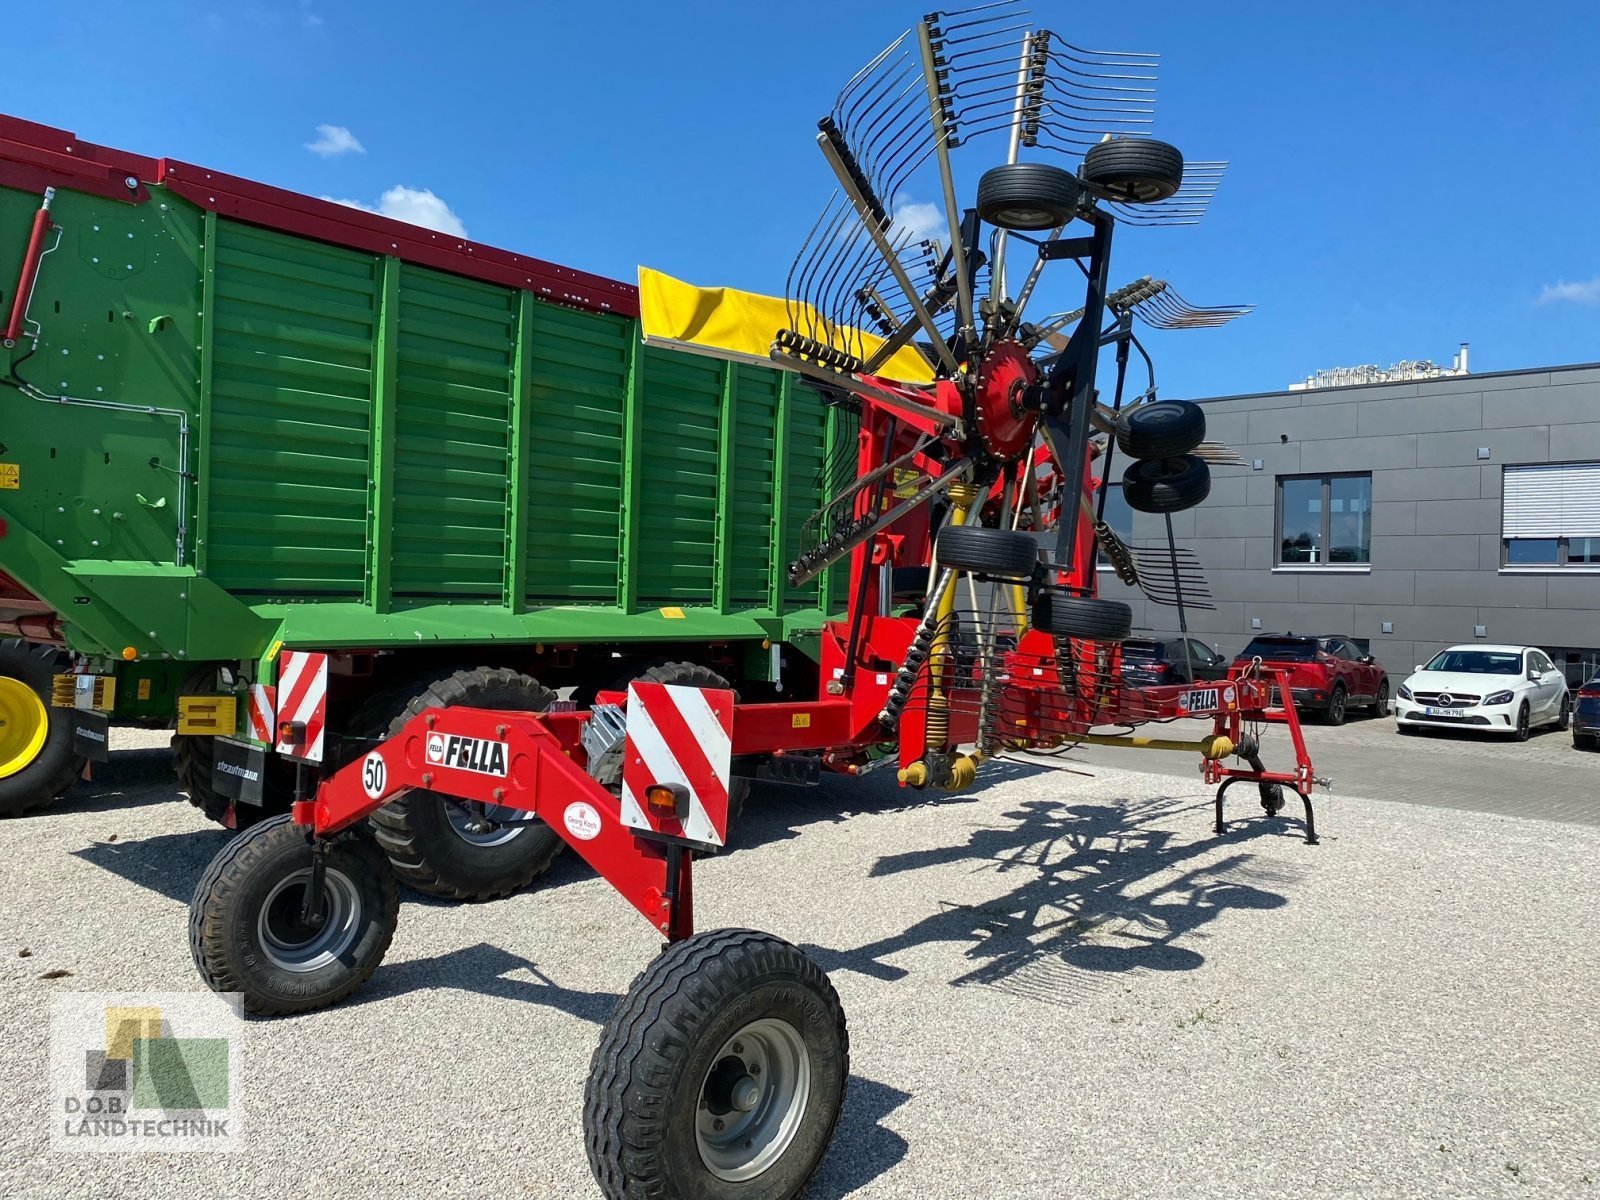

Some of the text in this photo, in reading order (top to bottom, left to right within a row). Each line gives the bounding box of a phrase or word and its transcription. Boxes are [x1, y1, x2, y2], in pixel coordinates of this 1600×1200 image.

[1189, 689, 1217, 712] FELLA
[429, 744, 442, 753] FELLA
[444, 736, 505, 775] FELLA
[365, 758, 383, 792] 50
